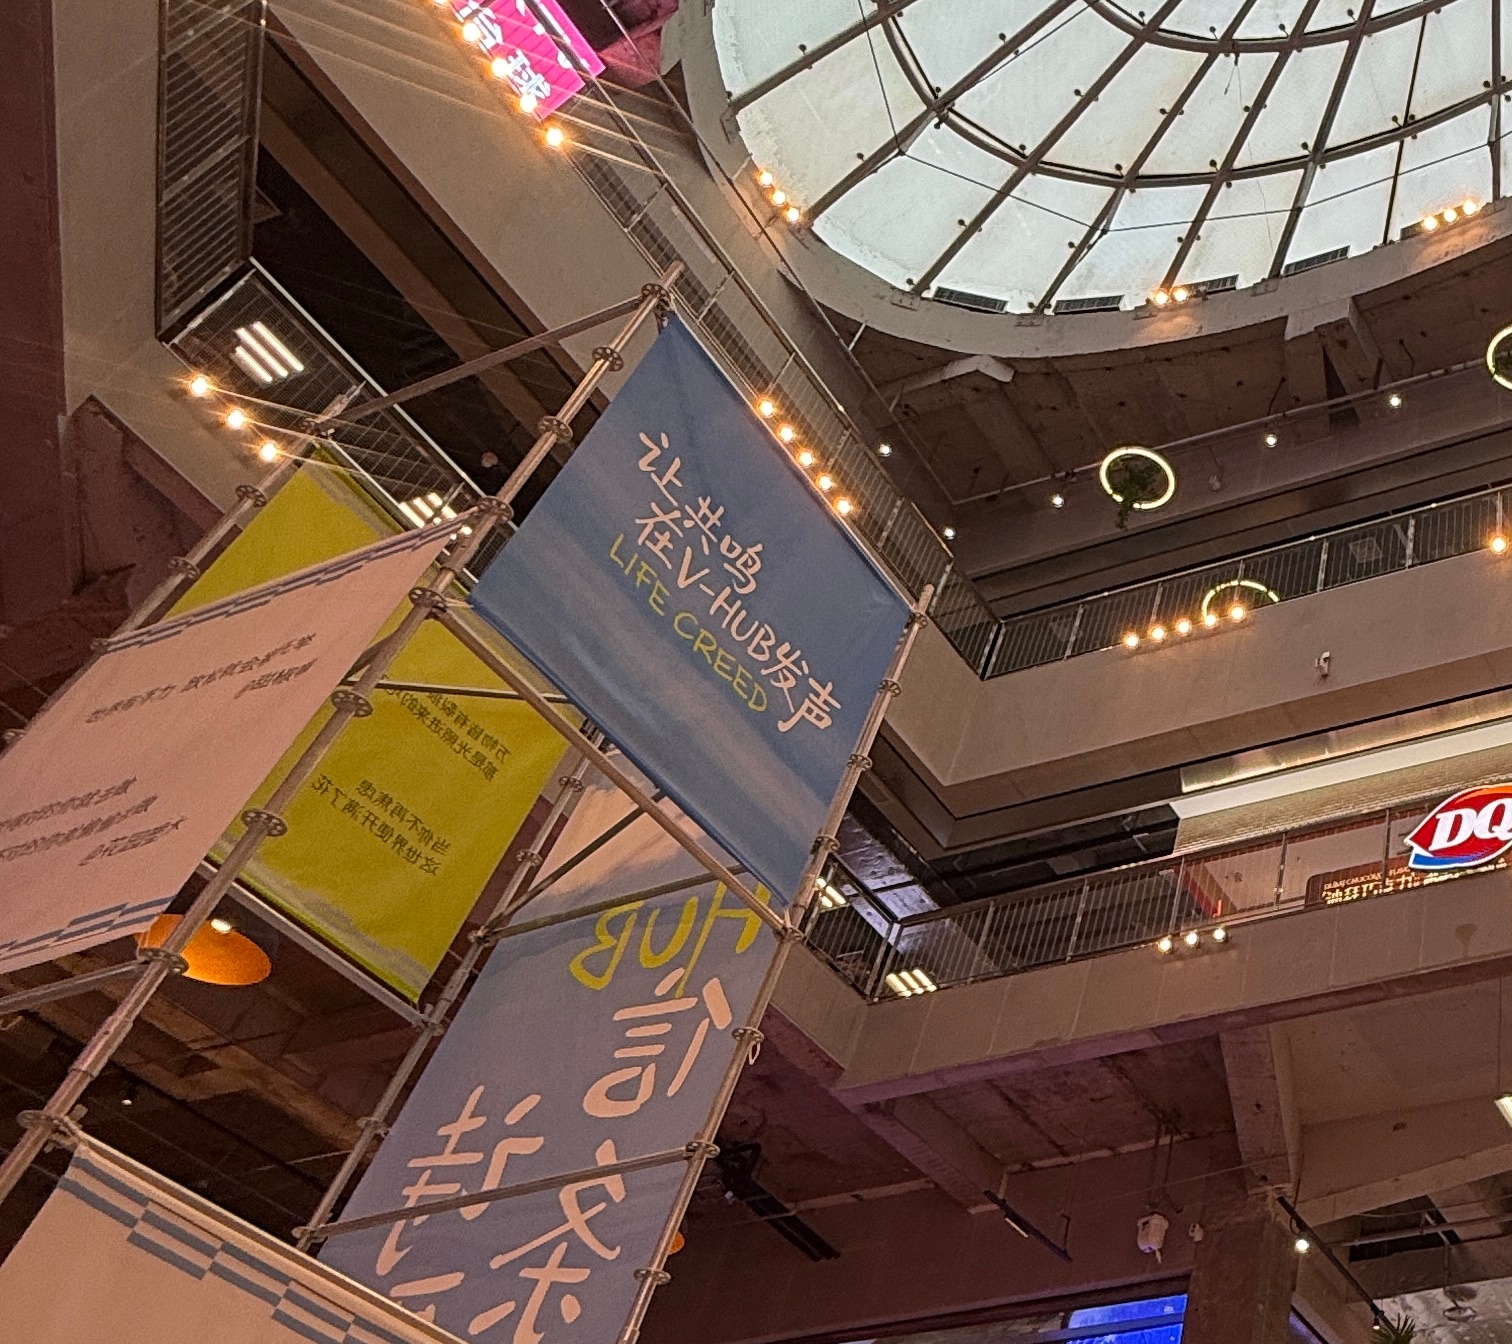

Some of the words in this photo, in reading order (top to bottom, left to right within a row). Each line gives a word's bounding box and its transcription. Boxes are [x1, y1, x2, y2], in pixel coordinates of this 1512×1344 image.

[637, 430, 765, 596] 让共鸣
[608, 539, 670, 621] LIFE
[672, 602, 772, 716] CREED
